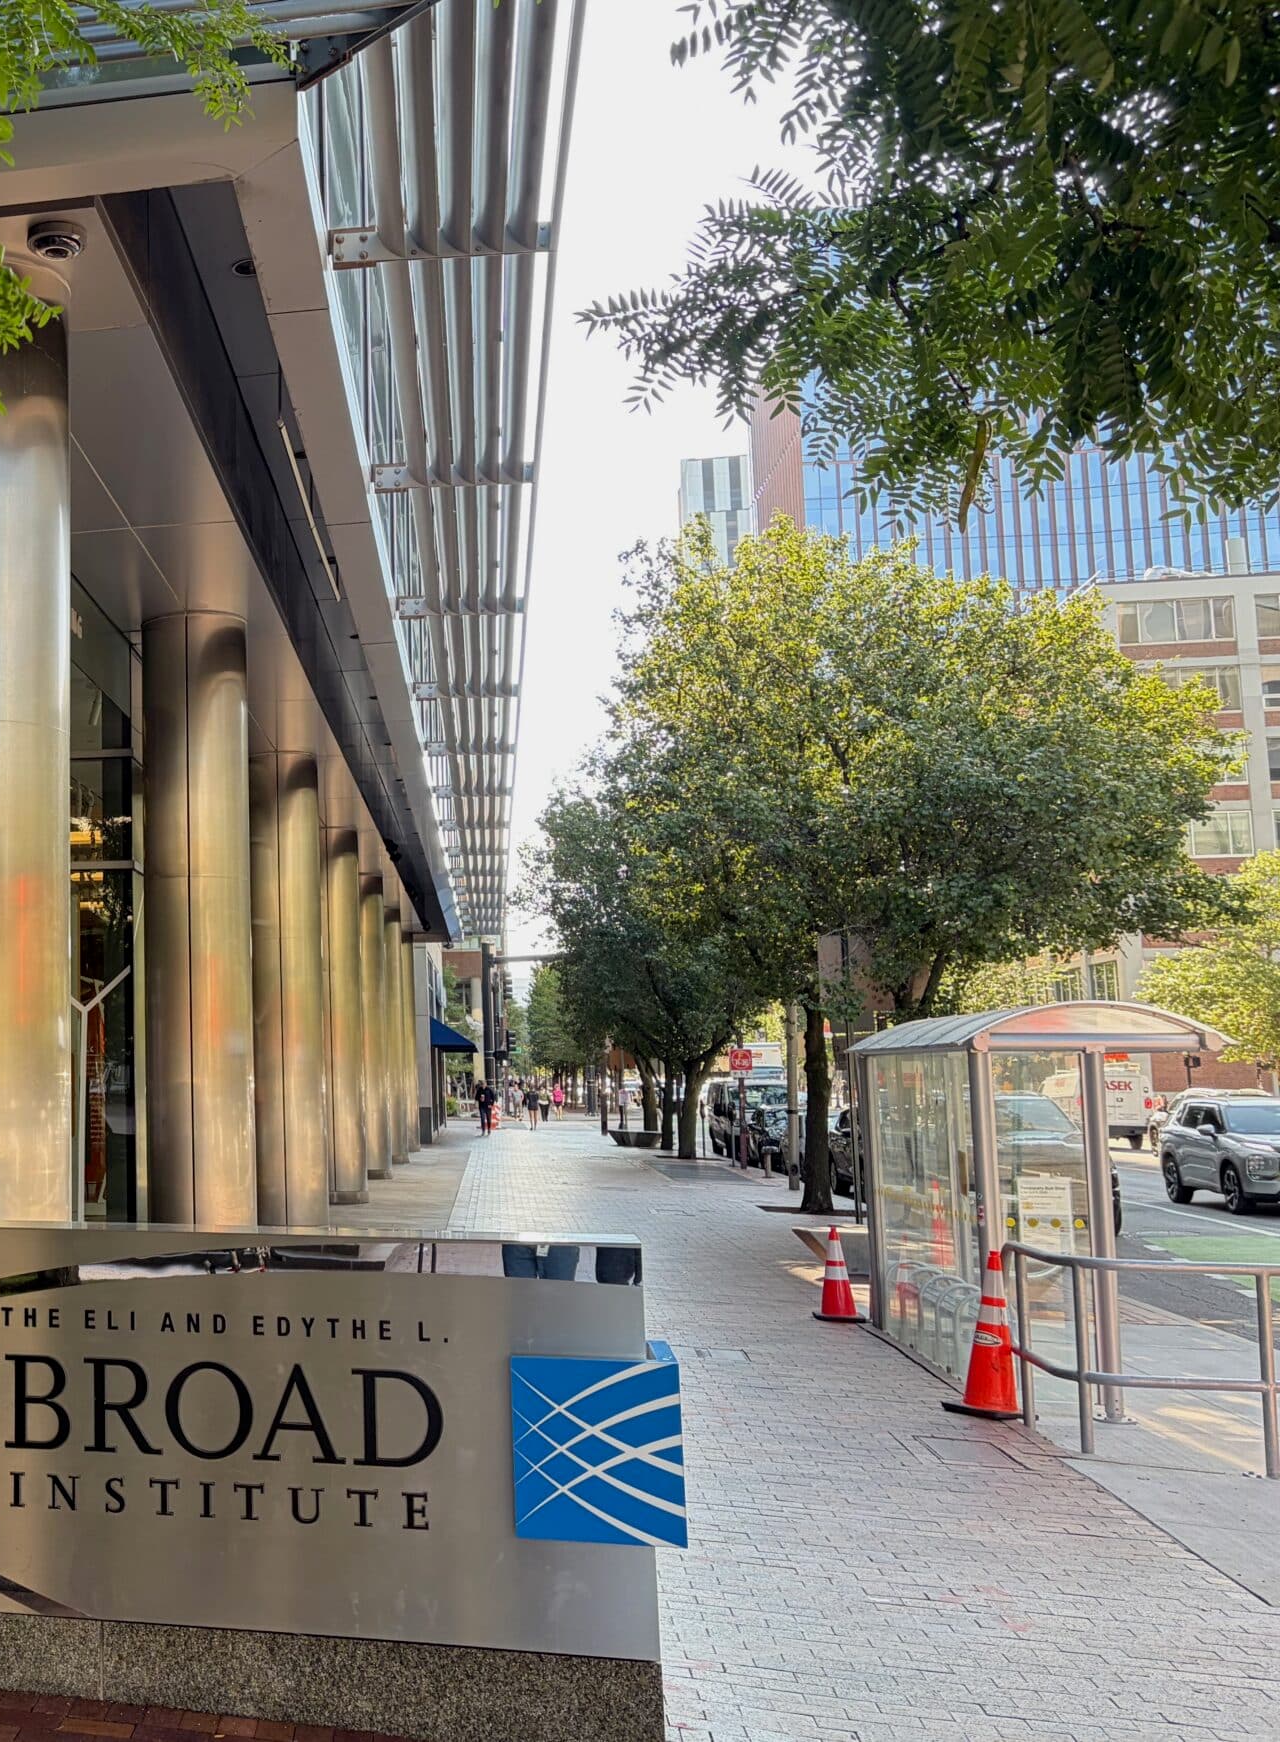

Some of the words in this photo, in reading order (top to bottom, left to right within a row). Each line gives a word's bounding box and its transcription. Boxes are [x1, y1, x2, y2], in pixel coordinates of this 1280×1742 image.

[0, 1306, 60, 1329] THE
[84, 1309, 137, 1331] ELI
[160, 1312, 227, 1334] AND
[252, 1315, 392, 1341] EDYTHE
[418, 1321, 449, 1343] L.
[4, 1354, 444, 1468] BROAD
[9, 1471, 430, 1530] INSTITUTE
